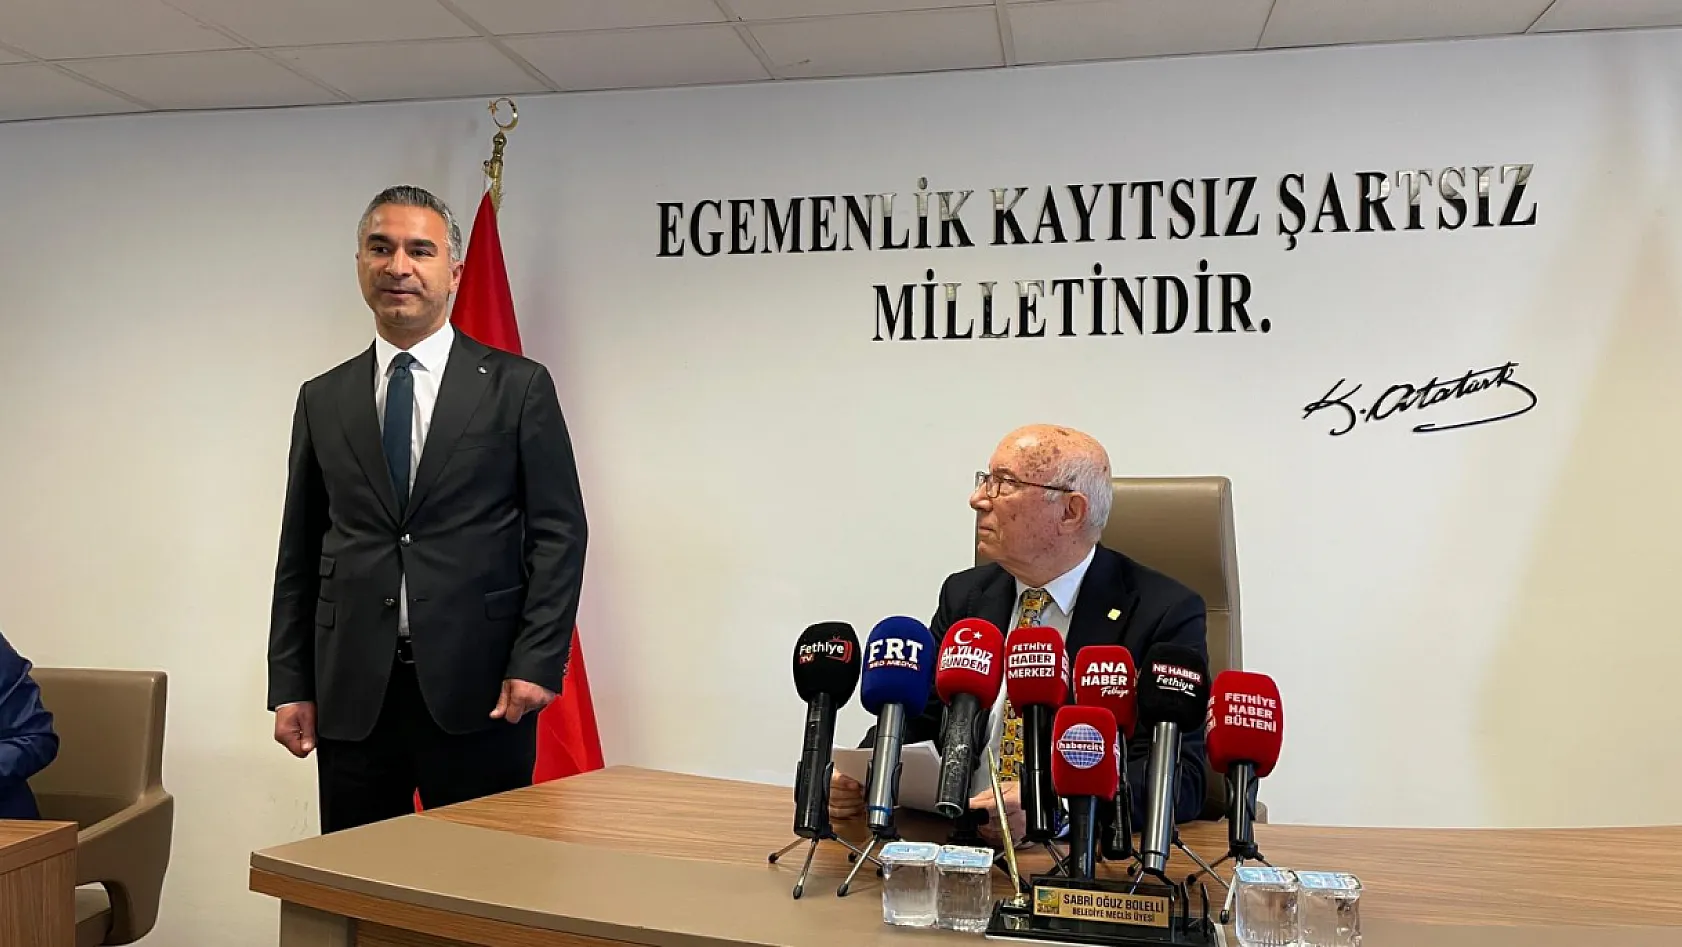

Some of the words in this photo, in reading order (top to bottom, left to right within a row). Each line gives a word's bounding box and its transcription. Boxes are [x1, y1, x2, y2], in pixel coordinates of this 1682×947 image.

[656, 177, 976, 258] EGEMENLİK
[989, 176, 1260, 246] KAYITSIZ
[1277, 163, 1538, 251] ŞARTSIZ
[872, 258, 1271, 342] MİLLETİNDİR.
[800, 641, 845, 655] Fethiye
[868, 638, 924, 664] FRT
[941, 645, 956, 657] AY
[957, 645, 994, 661] YILDIZ
[1011, 641, 1053, 652] FETHİYE
[941, 655, 989, 673] GÜNDEM
[1010, 654, 1052, 665] HABER
[1086, 661, 1127, 674] ANA
[1008, 666, 1055, 679] MERKEZİ
[1081, 674, 1128, 686] HABER
[1152, 663, 1167, 673] NE
[1168, 666, 1201, 682] HABER
[1156, 674, 1194, 691] Fethiye
[1224, 692, 1276, 709] FETHİYE
[1228, 704, 1273, 719] HABER
[1224, 714, 1277, 732] BÜLTENİ
[1063, 893, 1093, 907] SABRİ
[1096, 895, 1123, 909] OĞUZ
[1125, 899, 1164, 913] BOLELLİ
[1072, 906, 1104, 918] BELEDİYE
[1106, 910, 1132, 920] MECLİS
